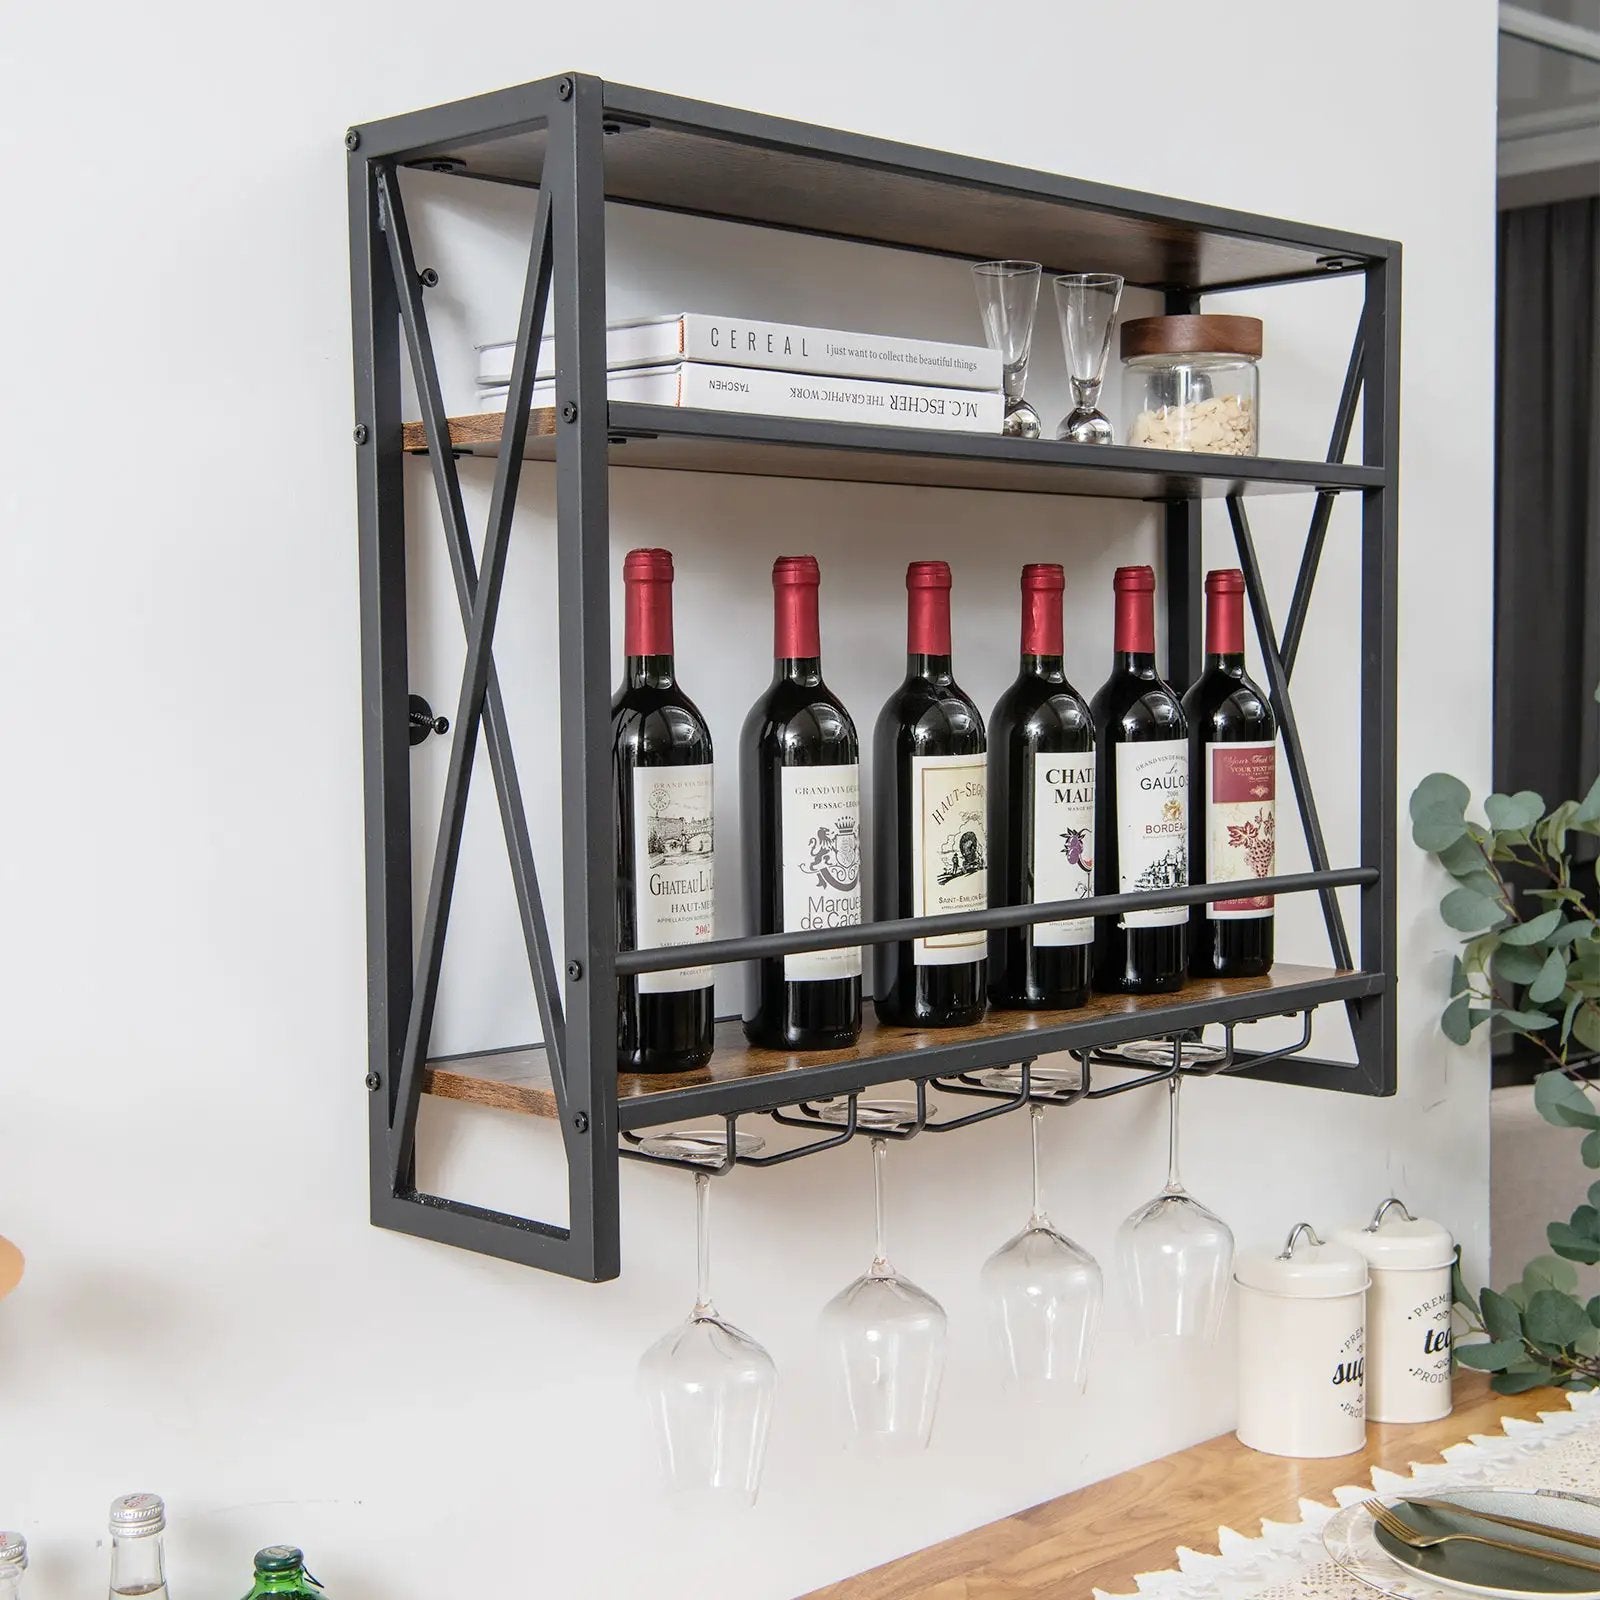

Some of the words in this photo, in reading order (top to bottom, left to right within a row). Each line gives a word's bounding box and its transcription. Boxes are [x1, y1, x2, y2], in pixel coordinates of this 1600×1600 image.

[711, 327, 809, 357] CEREAL
[830, 344, 846, 357] just
[847, 347, 867, 359] want
[869, 348, 878, 360] to
[879, 350, 904, 362] collect
[905, 352, 918, 364] the
[918, 354, 953, 368] beautiful
[953, 358, 978, 372] things
[708, 380, 750, 393] TASCHEN
[789, 387, 820, 401] WORK
[820, 390, 866, 405] GRAPHIC
[866, 394, 885, 407] THE
[889, 394, 945, 415] ESCHER
[948, 400, 978, 418] M.C.
[794, 786, 830, 795] GRAND
[1413, 1293, 1449, 1317] PREM
